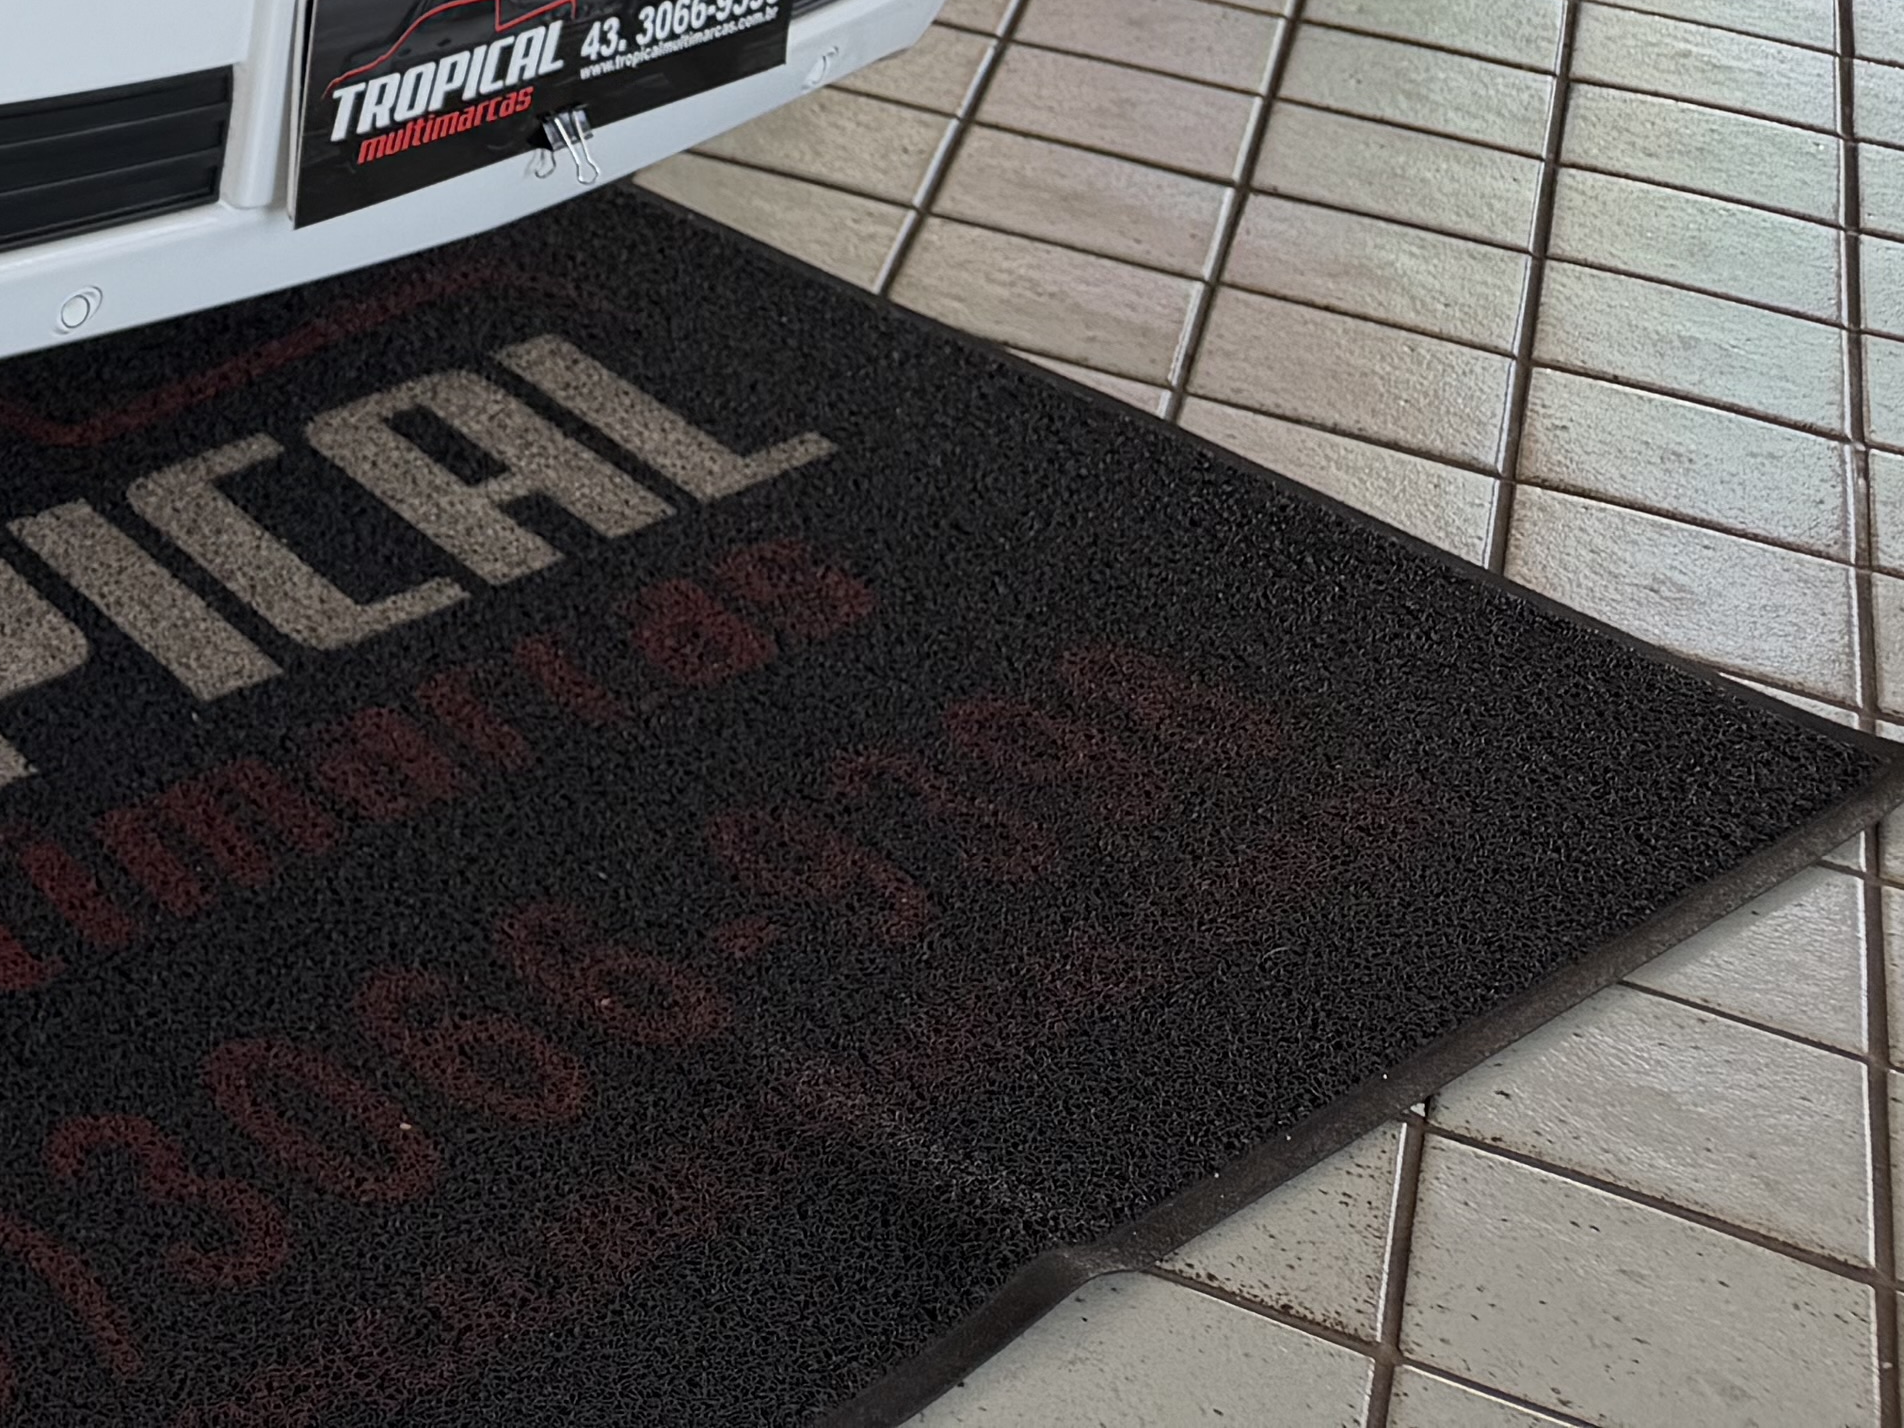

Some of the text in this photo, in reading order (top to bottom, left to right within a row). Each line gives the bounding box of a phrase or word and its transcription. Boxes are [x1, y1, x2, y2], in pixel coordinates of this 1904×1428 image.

[580, 16, 627, 60] 43.
[580, 5, 780, 80] www.tropicalmultimarcas.com.br
[330, 19, 565, 142] TROPICAL
[357, 85, 534, 165] multimarcas
